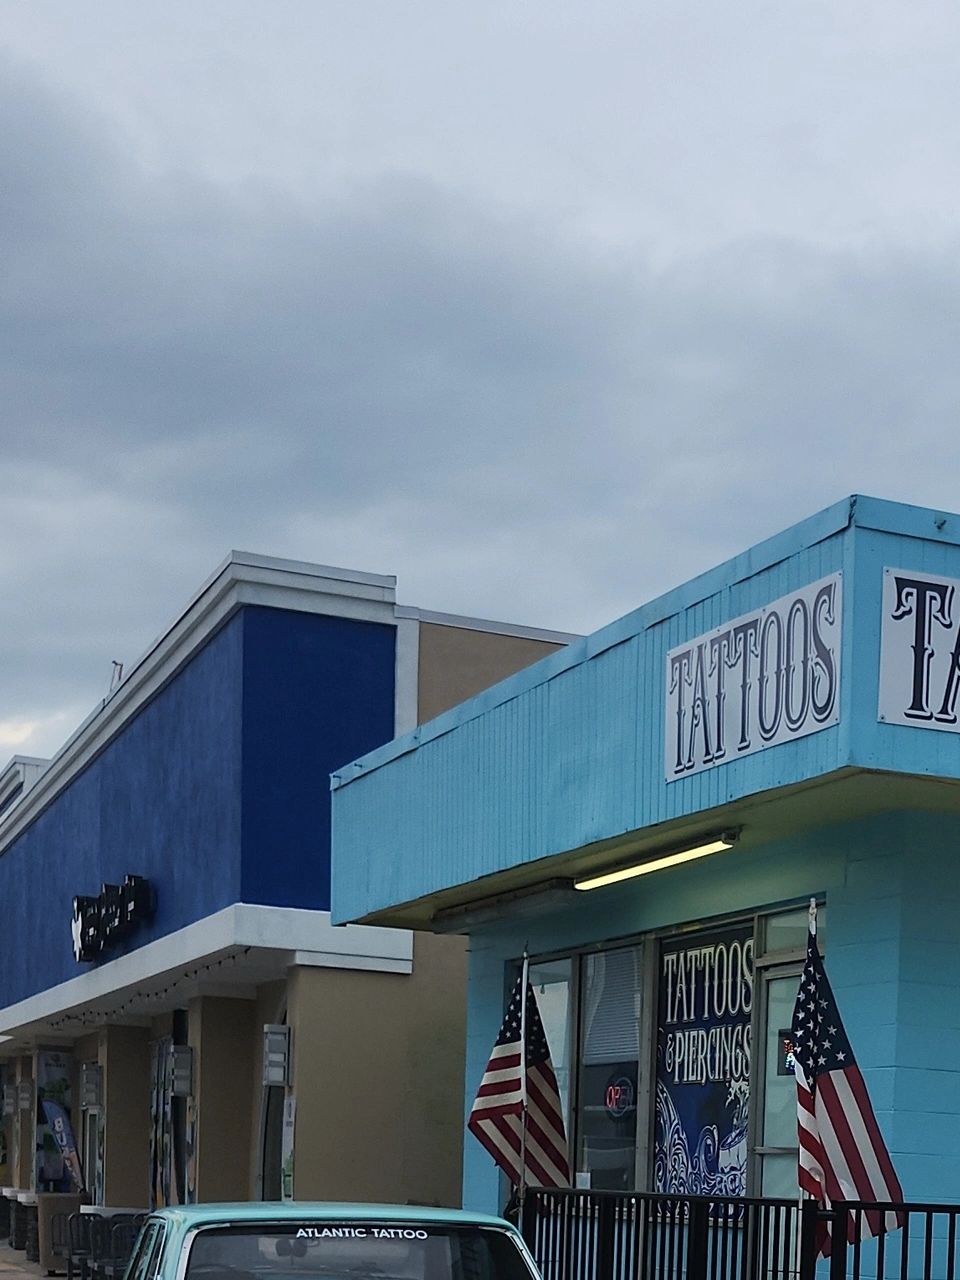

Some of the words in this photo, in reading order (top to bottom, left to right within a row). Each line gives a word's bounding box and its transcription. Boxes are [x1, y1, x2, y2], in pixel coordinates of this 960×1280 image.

[670, 581, 836, 775] TATTOOS
[663, 939, 754, 1024] TATTOOS
[665, 1033, 674, 1073] &
[674, 1024, 751, 1086] PIERCINGS
[296, 1228, 367, 1238] ATLANTIC
[371, 1228, 428, 1240] TATTOO
